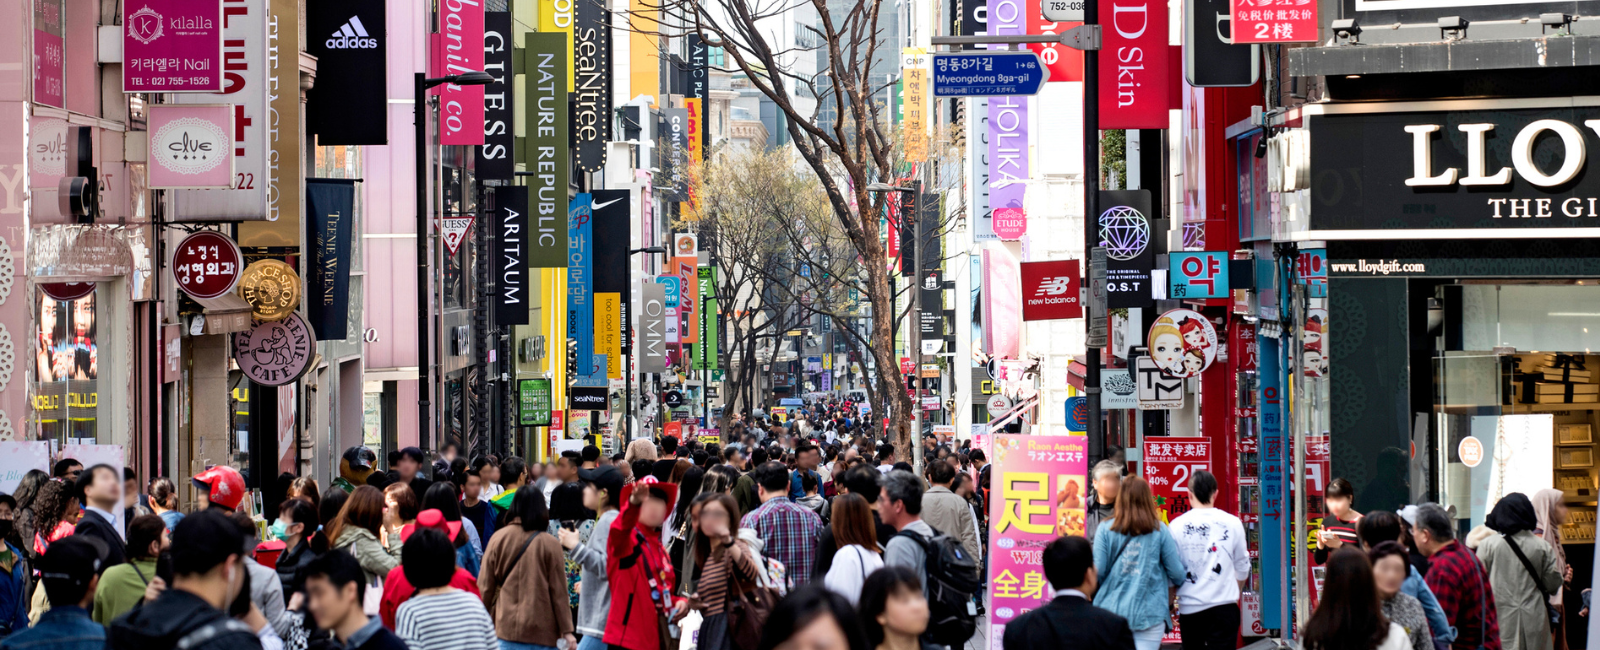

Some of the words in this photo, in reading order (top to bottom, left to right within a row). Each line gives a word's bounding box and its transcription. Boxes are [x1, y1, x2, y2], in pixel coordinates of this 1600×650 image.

[170, 16, 212, 29] kilalla
[326, 36, 377, 49] adidas
[131, 58, 180, 72] 키라엘라
[184, 58, 210, 70] Nail
[936, 57, 992, 72] 명동8가길
[131, 78, 144, 86] TEL
[168, 76, 210, 85] 755-1526
[579, 28, 602, 141] seaNtree
[937, 74, 996, 84] Myeongdong
[998, 74, 1029, 83] 8ga-gil
[1118, 46, 1144, 108] Skin
[482, 30, 506, 160] GUESS
[538, 54, 554, 138] NATURE
[538, 146, 555, 247] REPUBLIC
[1488, 198, 1552, 218] THE
[326, 210, 340, 254] TEENIE
[996, 220, 1024, 228] ETUDE
[504, 207, 520, 304] ARITAUM
[178, 262, 234, 284] 성형외과
[250, 267, 280, 282] FACE
[568, 234, 588, 304] 바오로딸
[1182, 255, 1220, 296] 약
[280, 274, 292, 307] SHOP
[324, 257, 338, 306] WEENIE
[246, 284, 257, 307] THE
[1044, 296, 1076, 305] balance
[646, 299, 662, 357] OMM
[250, 364, 292, 381] CAFE
[1028, 440, 1051, 452] Raon
[1054, 442, 1083, 452] Aesthe
[1149, 443, 1206, 456] 批发专卖店
[1028, 452, 1084, 464] ラオンエステ
[1149, 476, 1168, 486] 40%
[994, 472, 1055, 536] 足
[993, 569, 1047, 600] 全身
